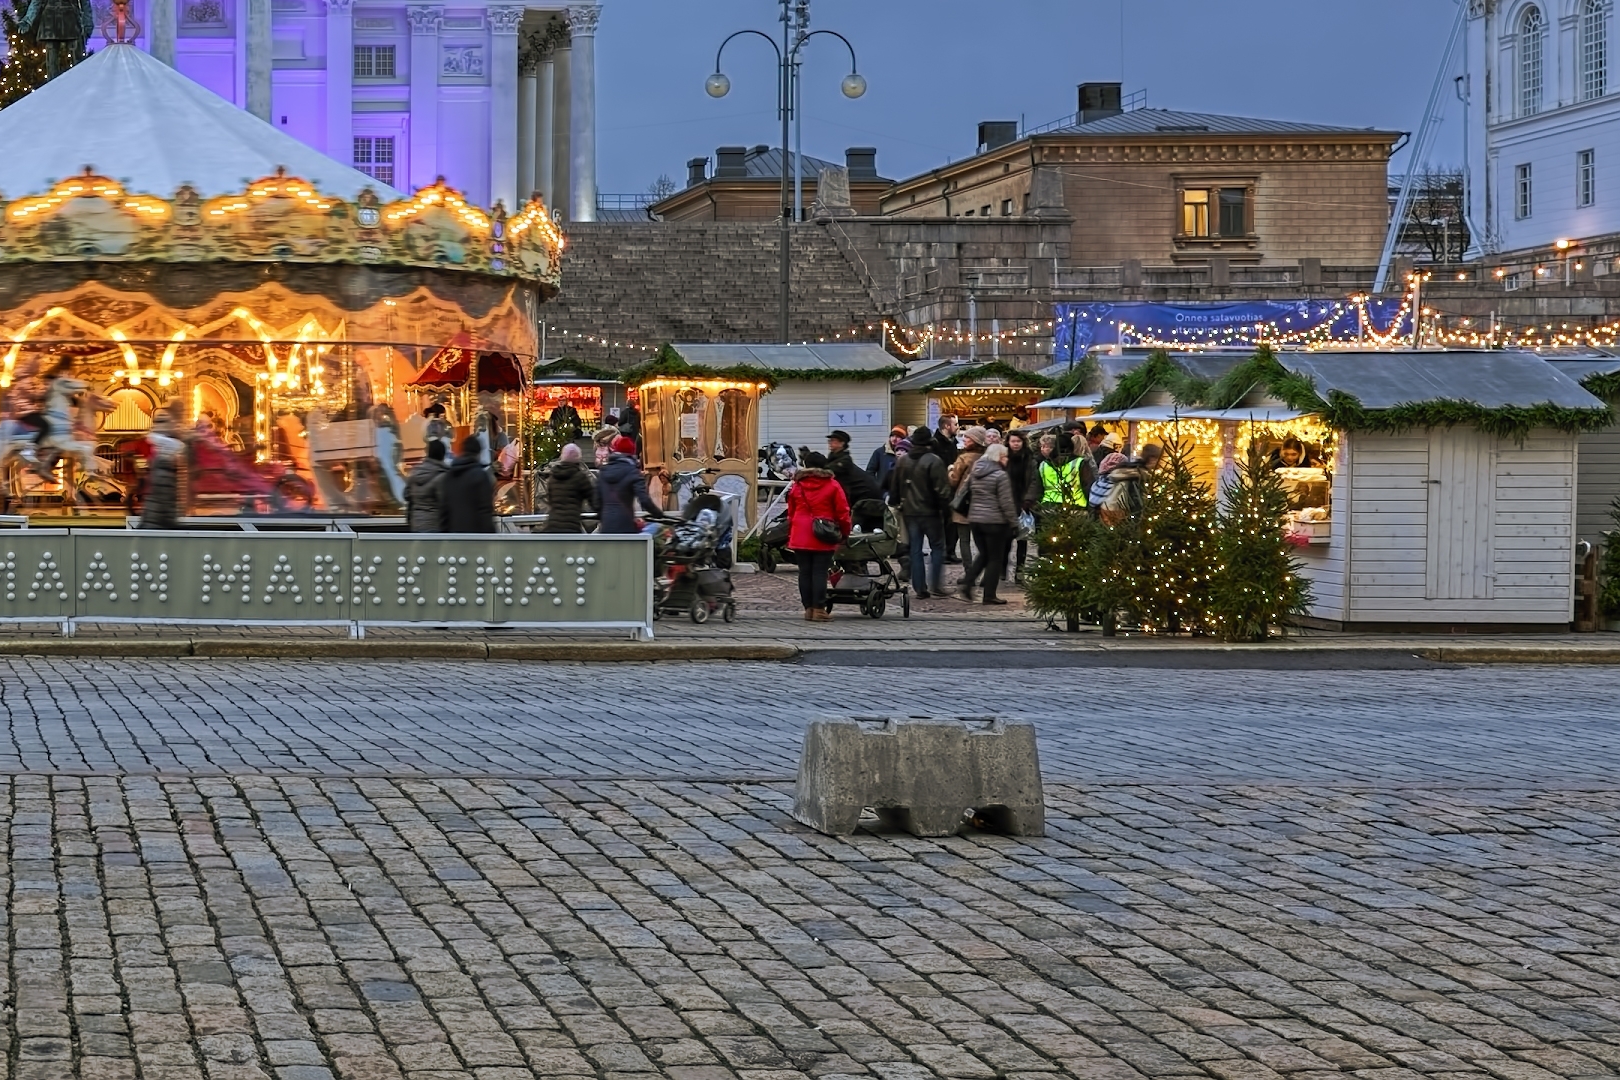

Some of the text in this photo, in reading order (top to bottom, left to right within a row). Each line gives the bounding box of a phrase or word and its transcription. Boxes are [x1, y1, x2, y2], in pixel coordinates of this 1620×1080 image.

[1175, 313, 1264, 322] Onnea satavuotias
[201, 554, 596, 606] MARKKINAT
